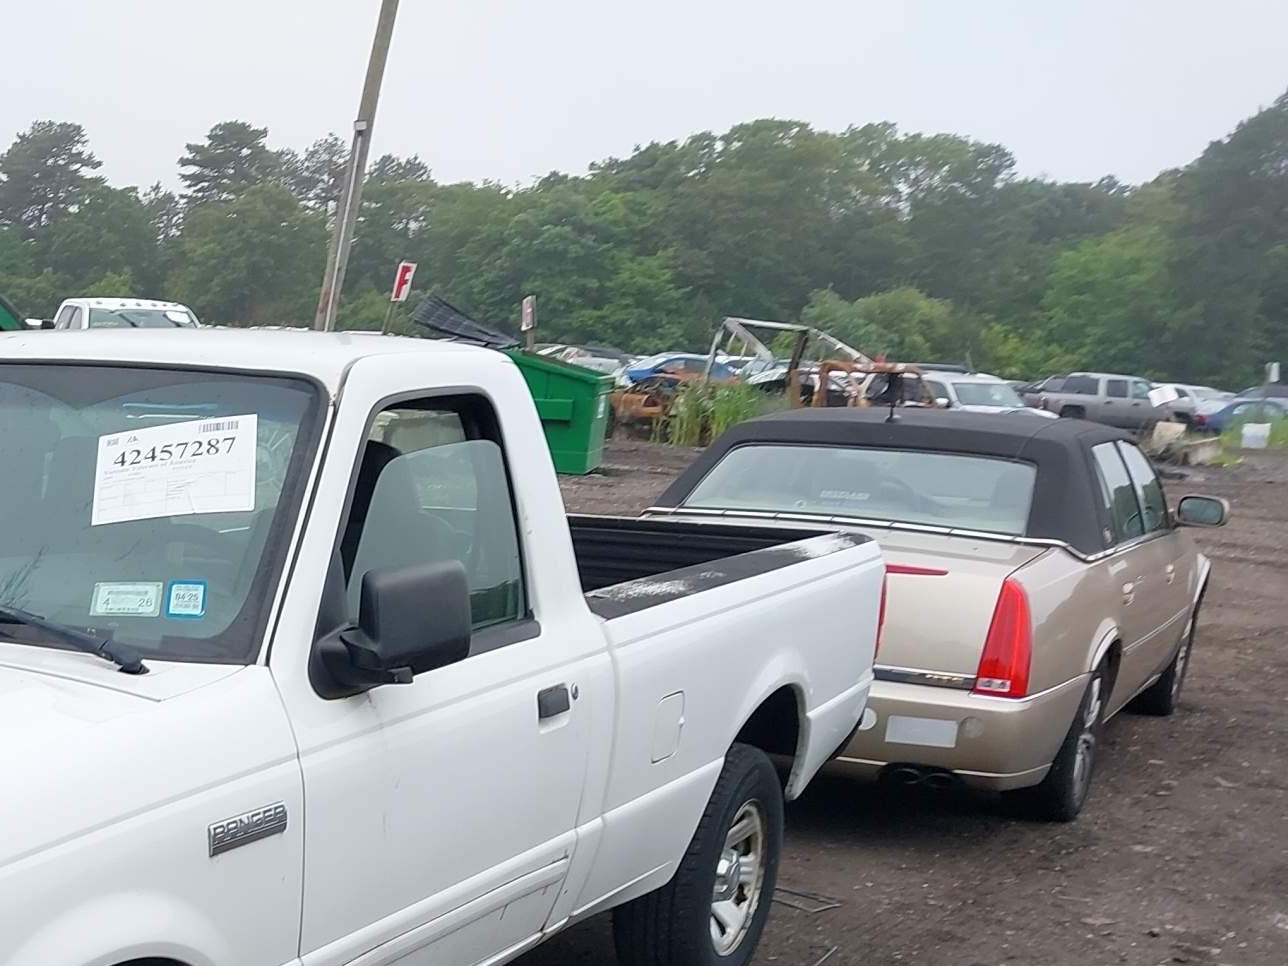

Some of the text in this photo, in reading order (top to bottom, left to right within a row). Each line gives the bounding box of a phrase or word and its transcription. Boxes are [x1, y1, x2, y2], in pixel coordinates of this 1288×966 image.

[394, 265, 412, 299] F
[113, 436, 236, 467] 42457287
[213, 804, 287, 845] RANGER
